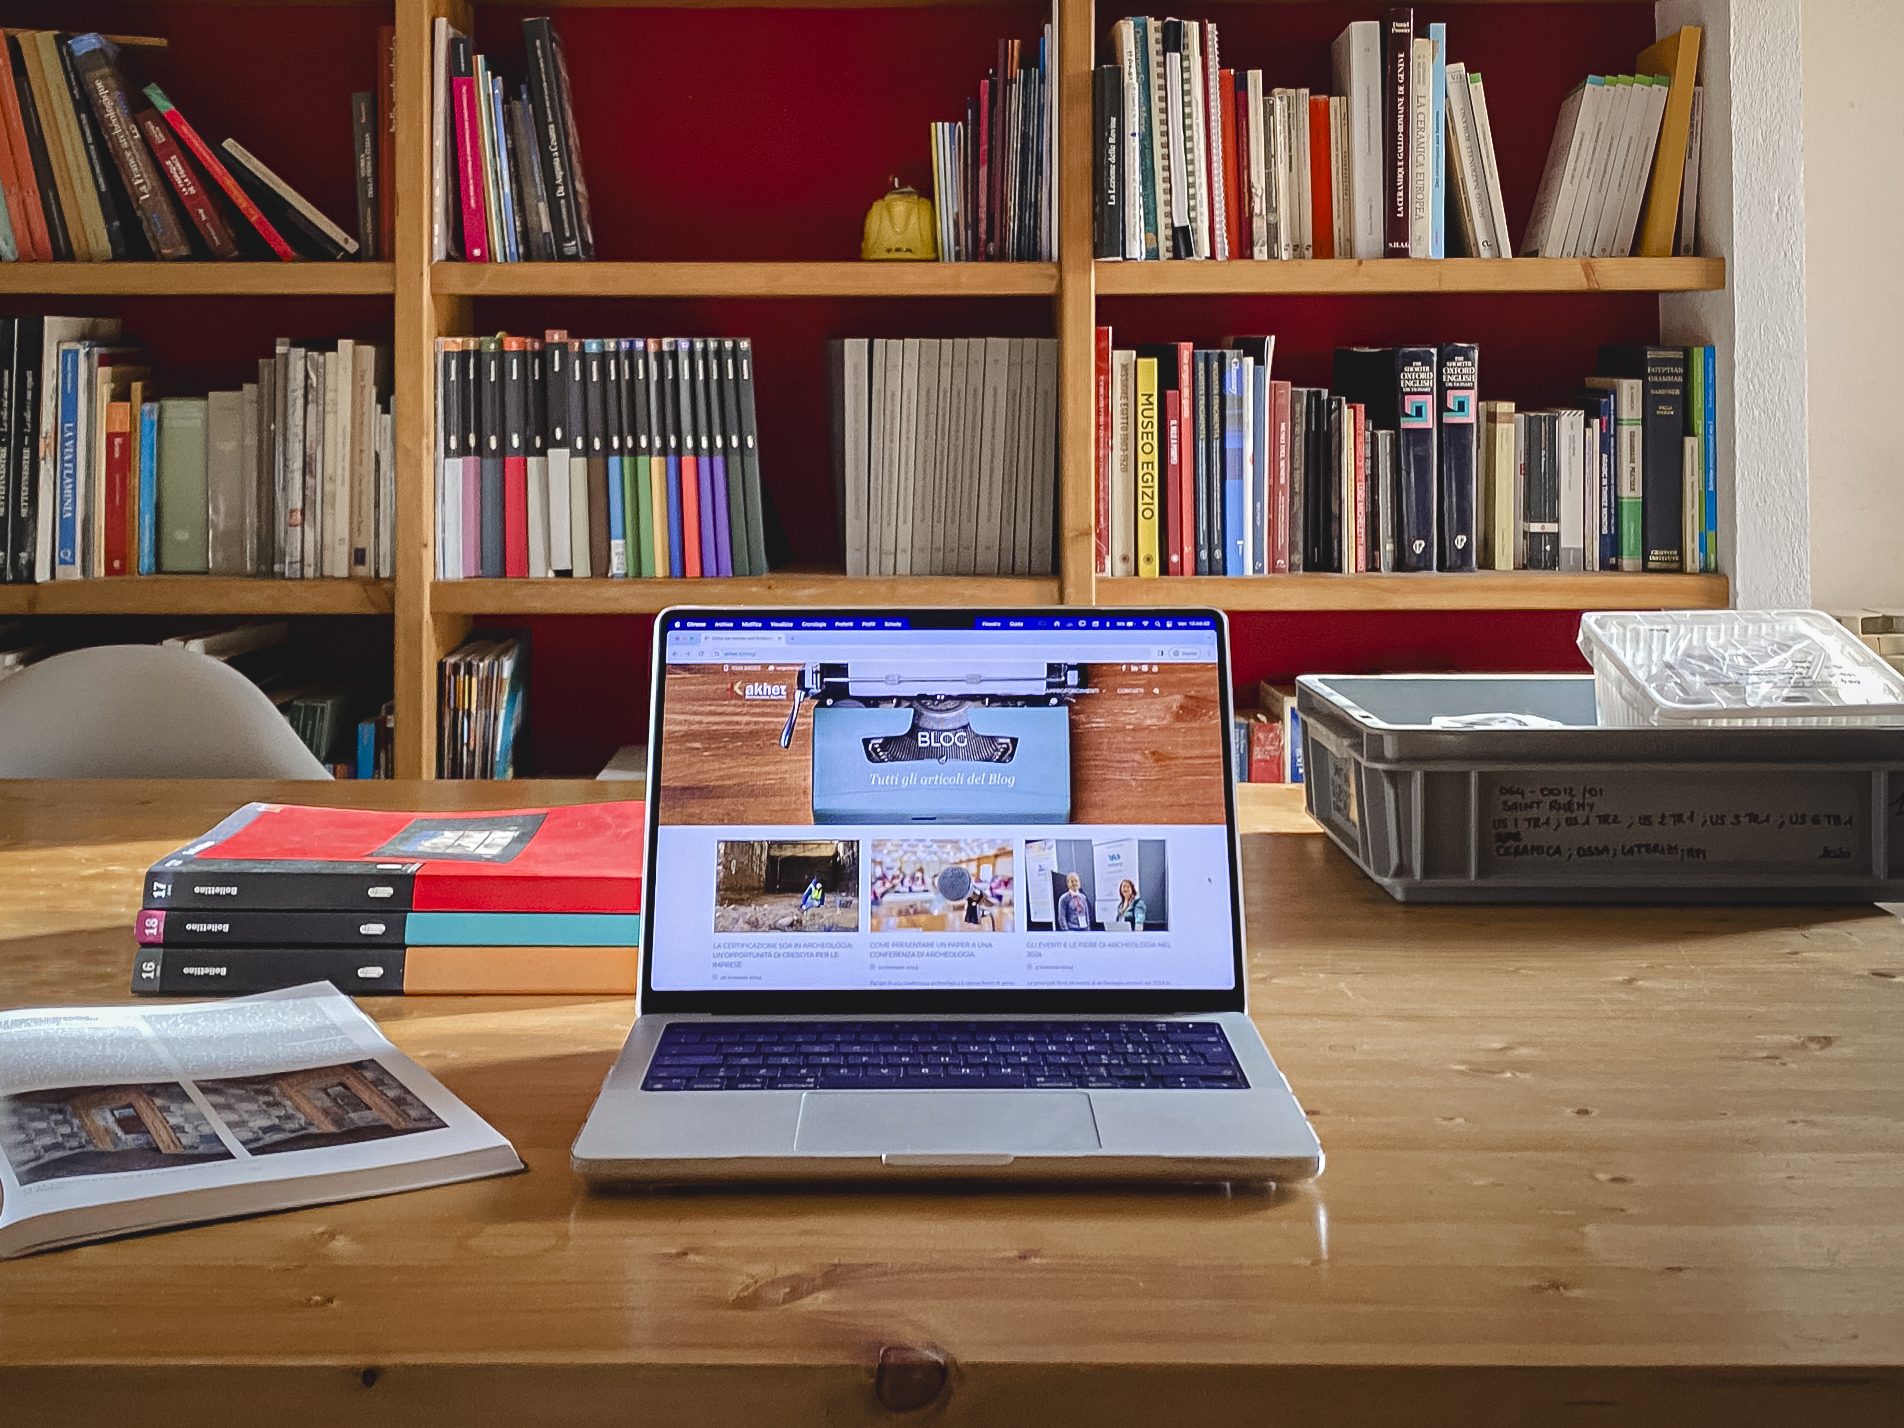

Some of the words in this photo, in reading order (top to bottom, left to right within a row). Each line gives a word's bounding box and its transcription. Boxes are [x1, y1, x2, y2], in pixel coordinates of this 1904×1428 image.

[1416, 94, 1426, 108] LA
[1415, 112, 1426, 168] CERAMICA
[1108, 164, 1116, 194] Lezione
[1108, 194, 1116, 206] La
[1414, 171, 1426, 221] EUROPEA
[1648, 366, 1683, 374] EGYPTIAN
[64, 422, 75, 437] LA
[1141, 393, 1154, 455] MUSEO
[64, 440, 74, 460] VIA
[62, 463, 74, 519] FLAMINIA
[1141, 461, 1154, 520] EGIZIO
[918, 732, 967, 747] BLOG
[870, 773, 898, 785] Tutti
[902, 773, 917, 787] gli
[920, 773, 964, 785] articoli
[967, 773, 985, 785] del
[988, 773, 1015, 787] Blog
[153, 882, 166, 898] 17
[194, 886, 238, 896] Bollettino
[144, 918, 159, 937] 18
[185, 923, 230, 933] Bollettino
[142, 961, 155, 980] 16
[182, 966, 227, 977] Bollettino
